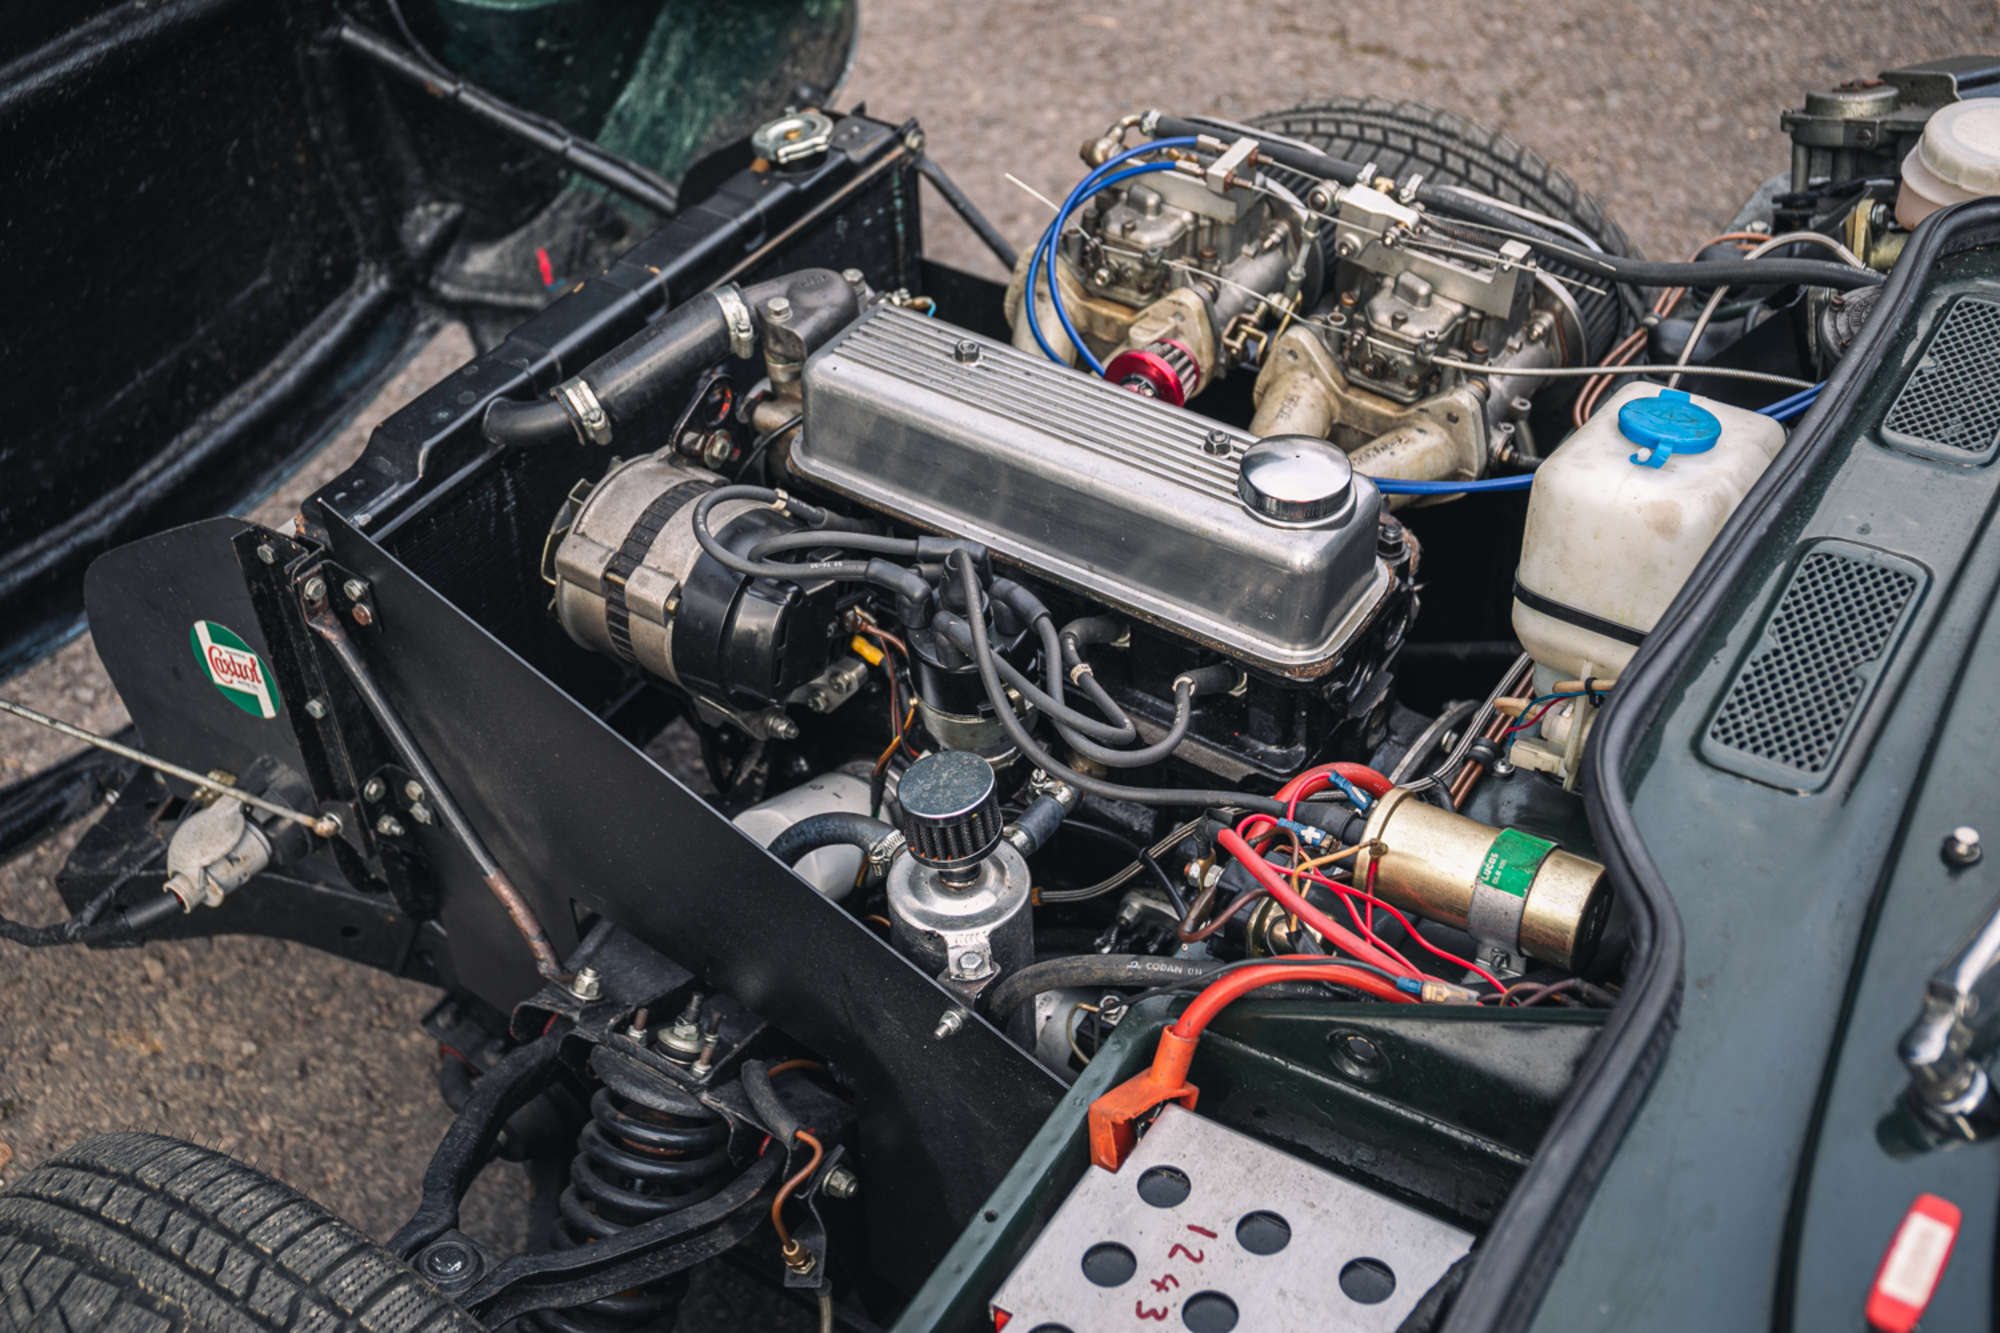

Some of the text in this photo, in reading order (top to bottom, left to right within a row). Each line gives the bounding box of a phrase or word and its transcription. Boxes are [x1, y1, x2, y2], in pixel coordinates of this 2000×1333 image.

[208, 645, 262, 684] Castrol
[1480, 853, 1499, 882] LUCAS
[1145, 962, 1184, 974] CODAN
